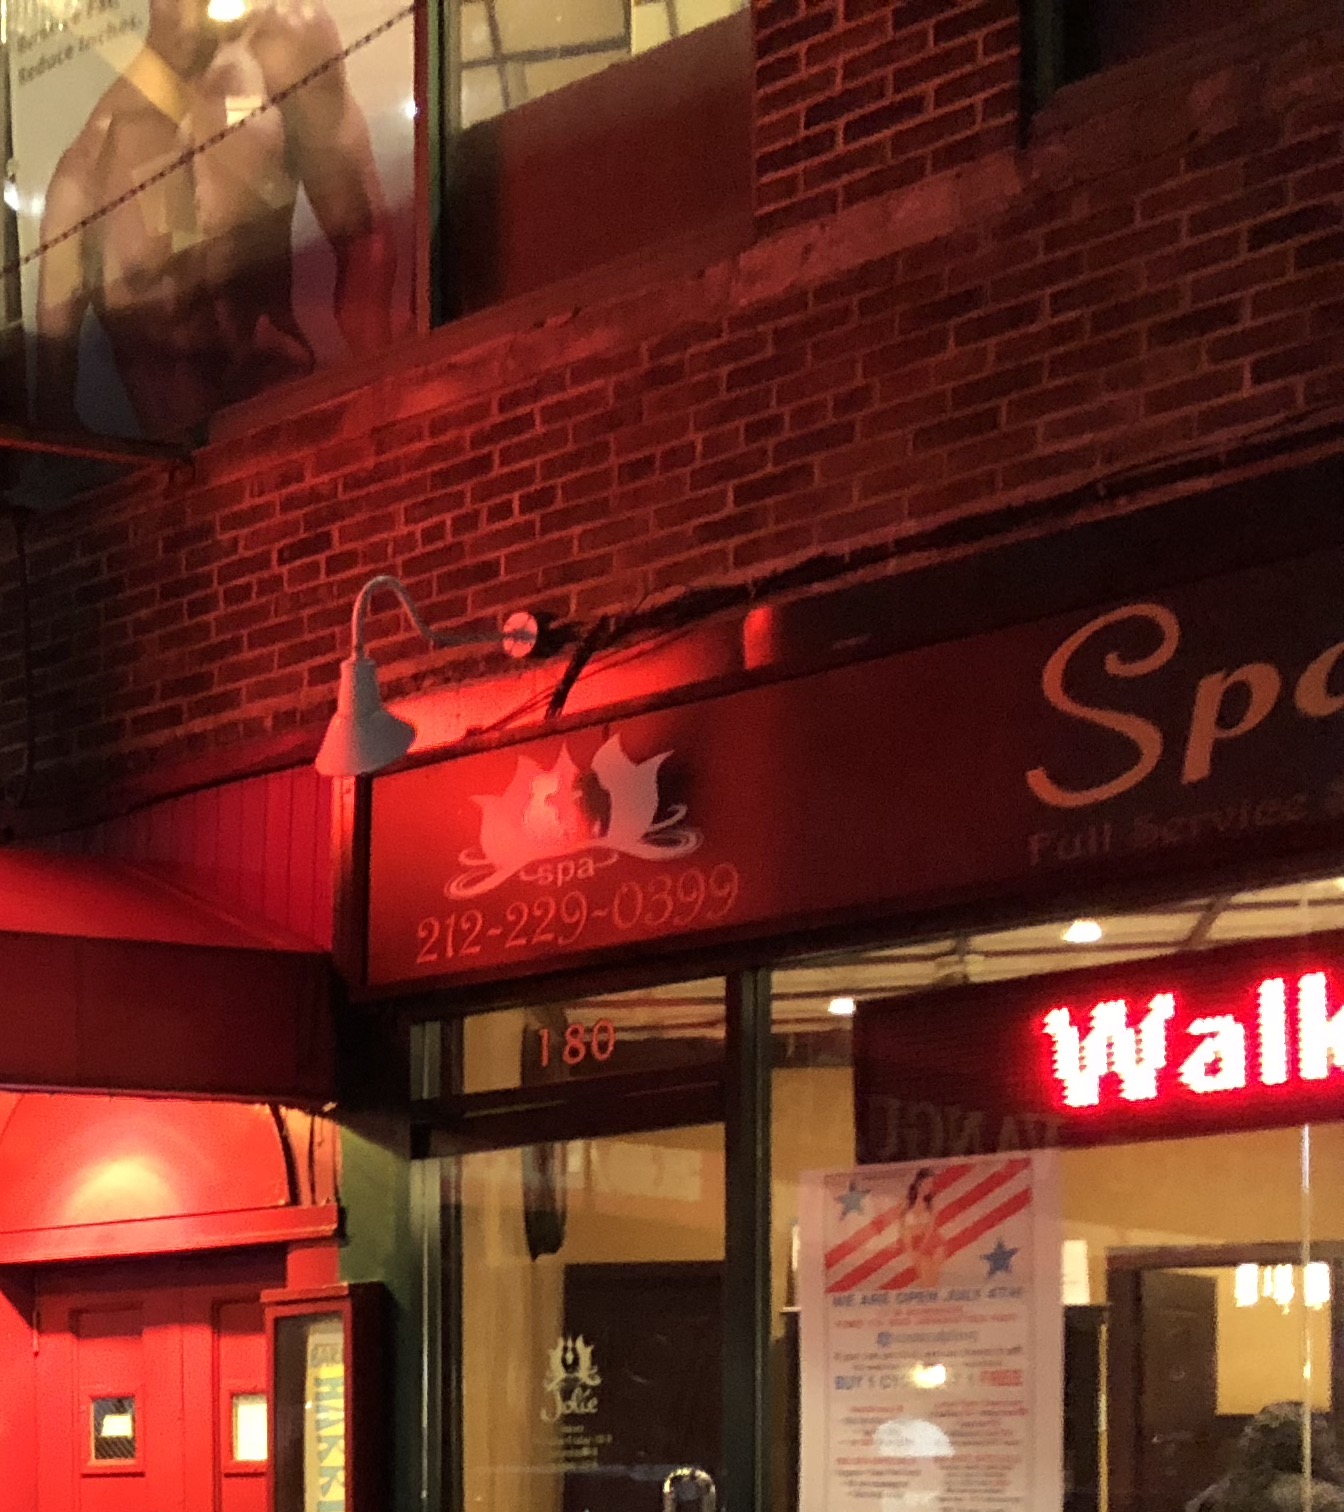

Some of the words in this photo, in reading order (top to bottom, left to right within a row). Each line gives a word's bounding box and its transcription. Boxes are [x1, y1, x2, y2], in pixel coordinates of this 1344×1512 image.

[532, 857, 597, 887] spa
[417, 864, 741, 965] 212-229-0399
[537, 1020, 617, 1067] 180
